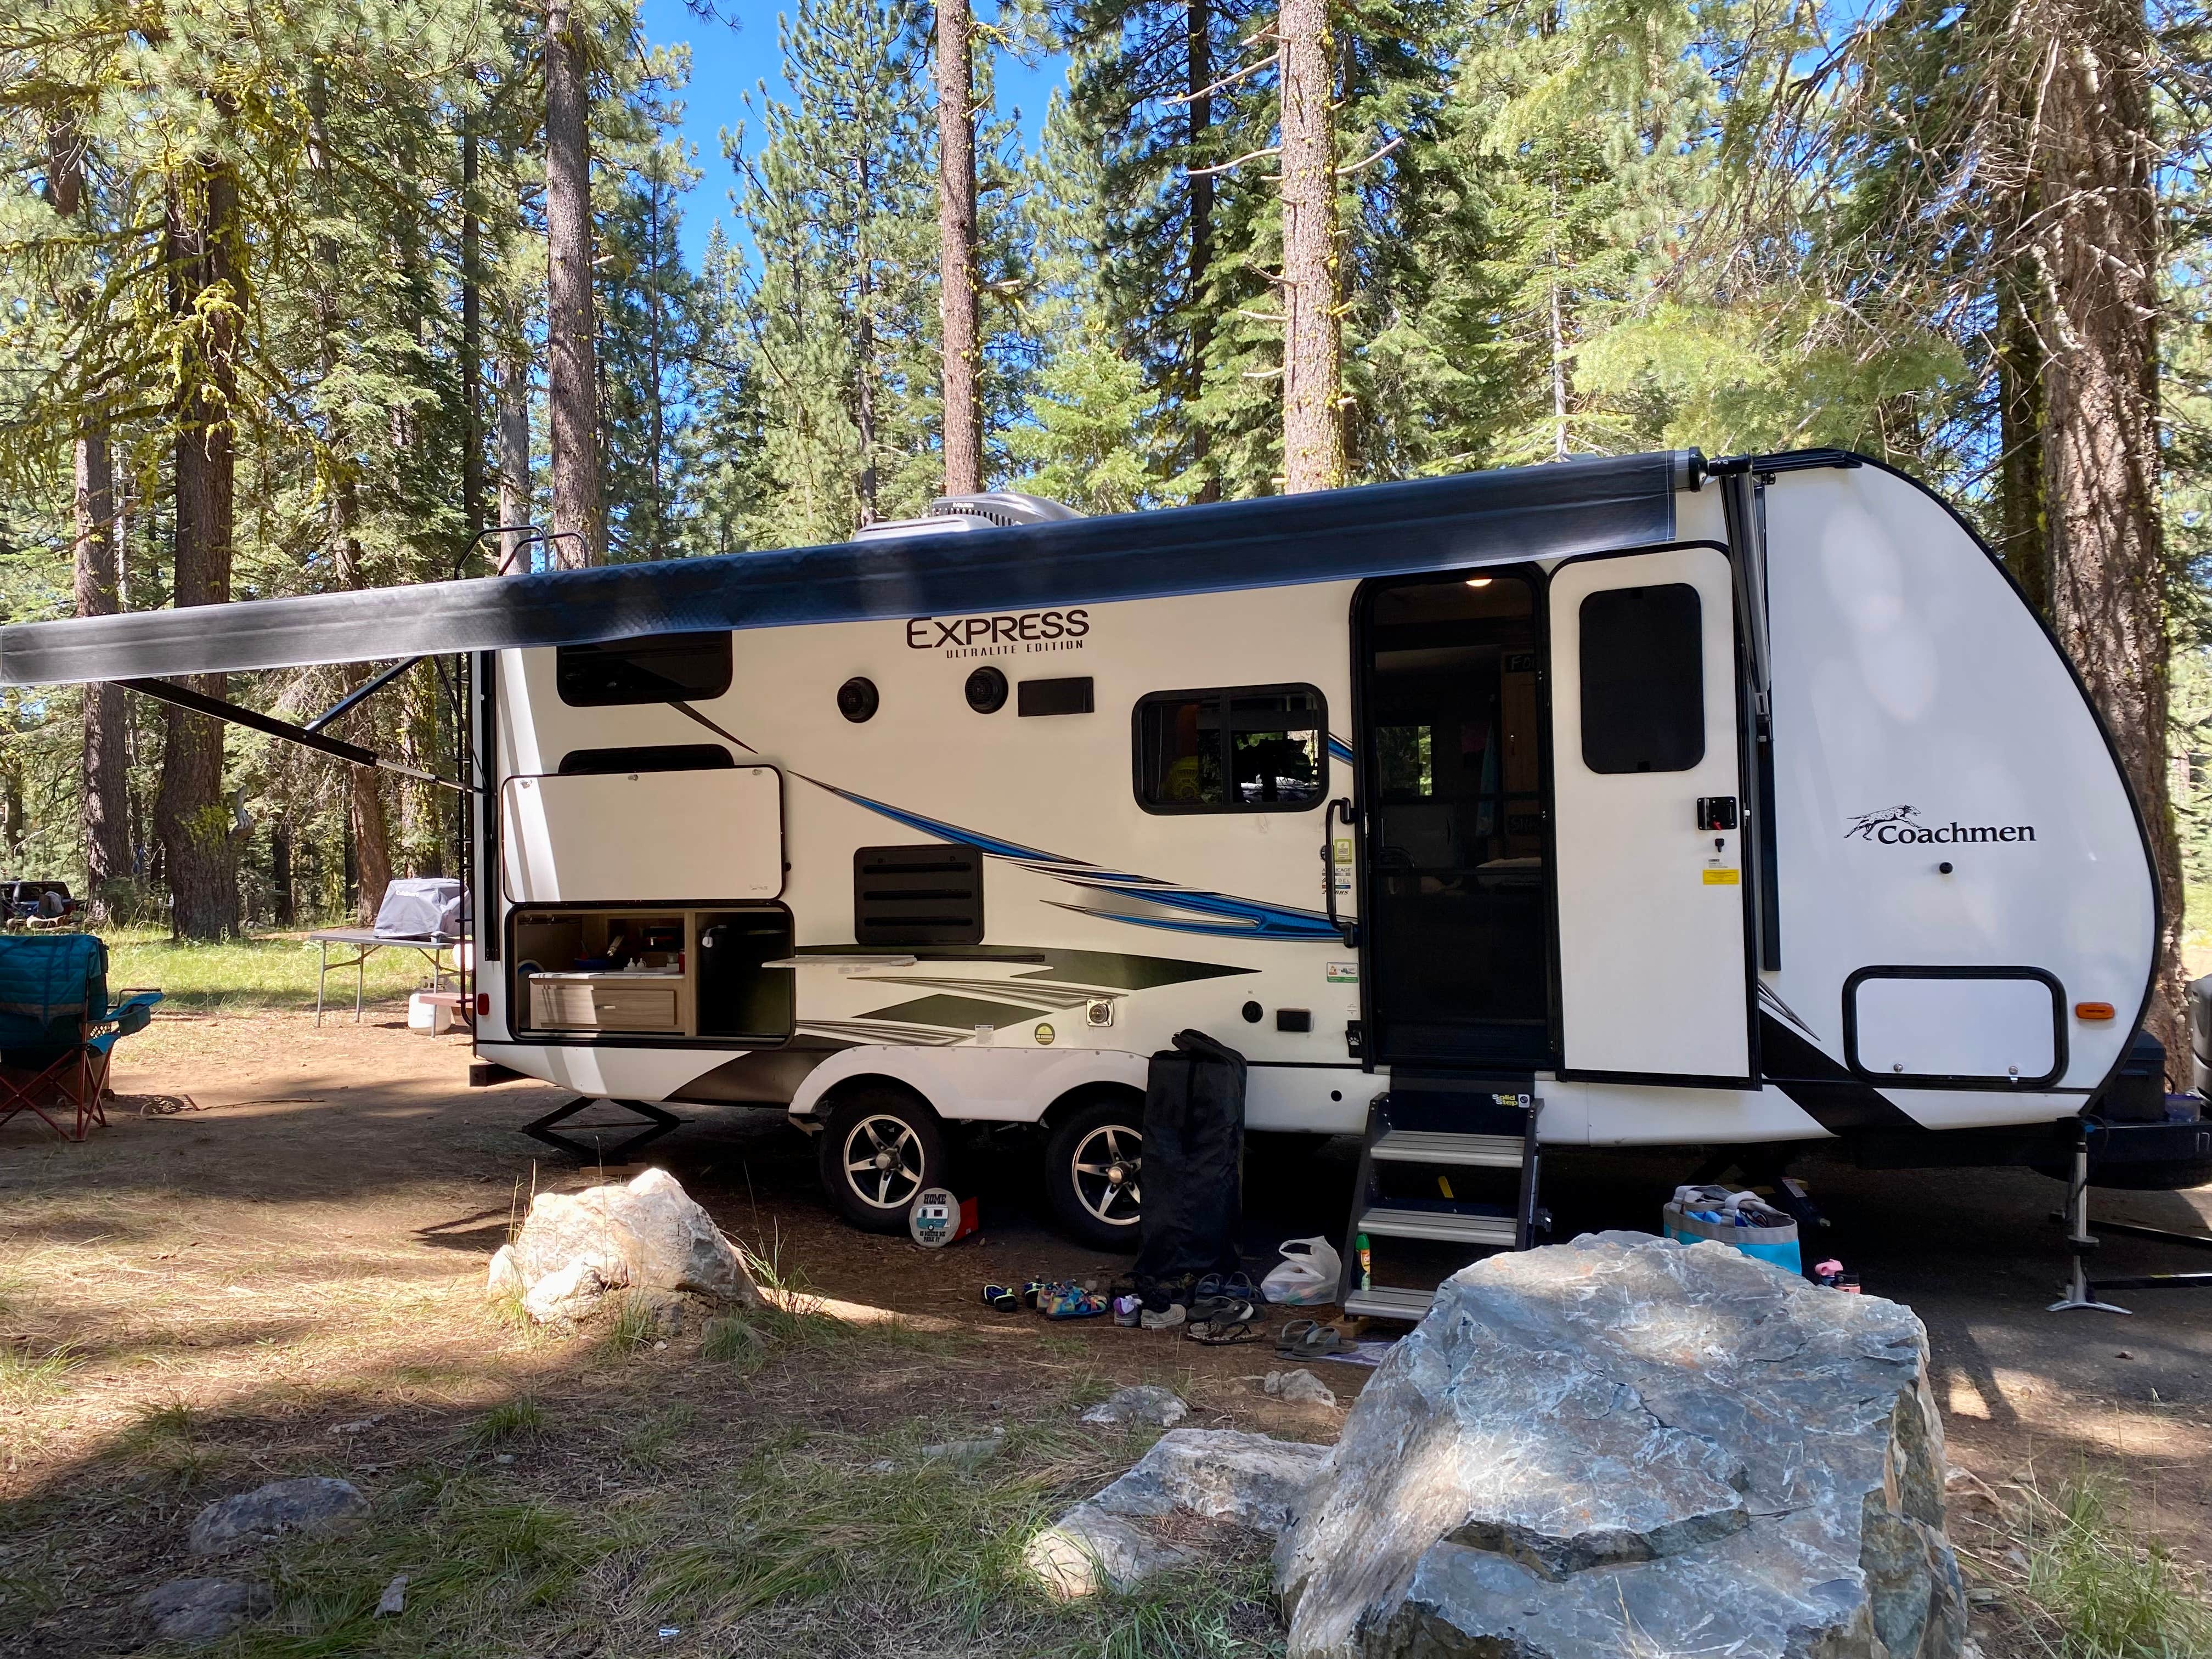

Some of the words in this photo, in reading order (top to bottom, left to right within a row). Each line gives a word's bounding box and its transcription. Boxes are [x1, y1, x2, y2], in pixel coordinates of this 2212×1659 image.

[907, 610, 1090, 649] EXPRESS
[946, 645, 1017, 658] ULTRALITE
[1027, 640, 1083, 653] EDITION
[1878, 822, 2036, 844] Coachmen
[924, 1193, 946, 1205] HOME
